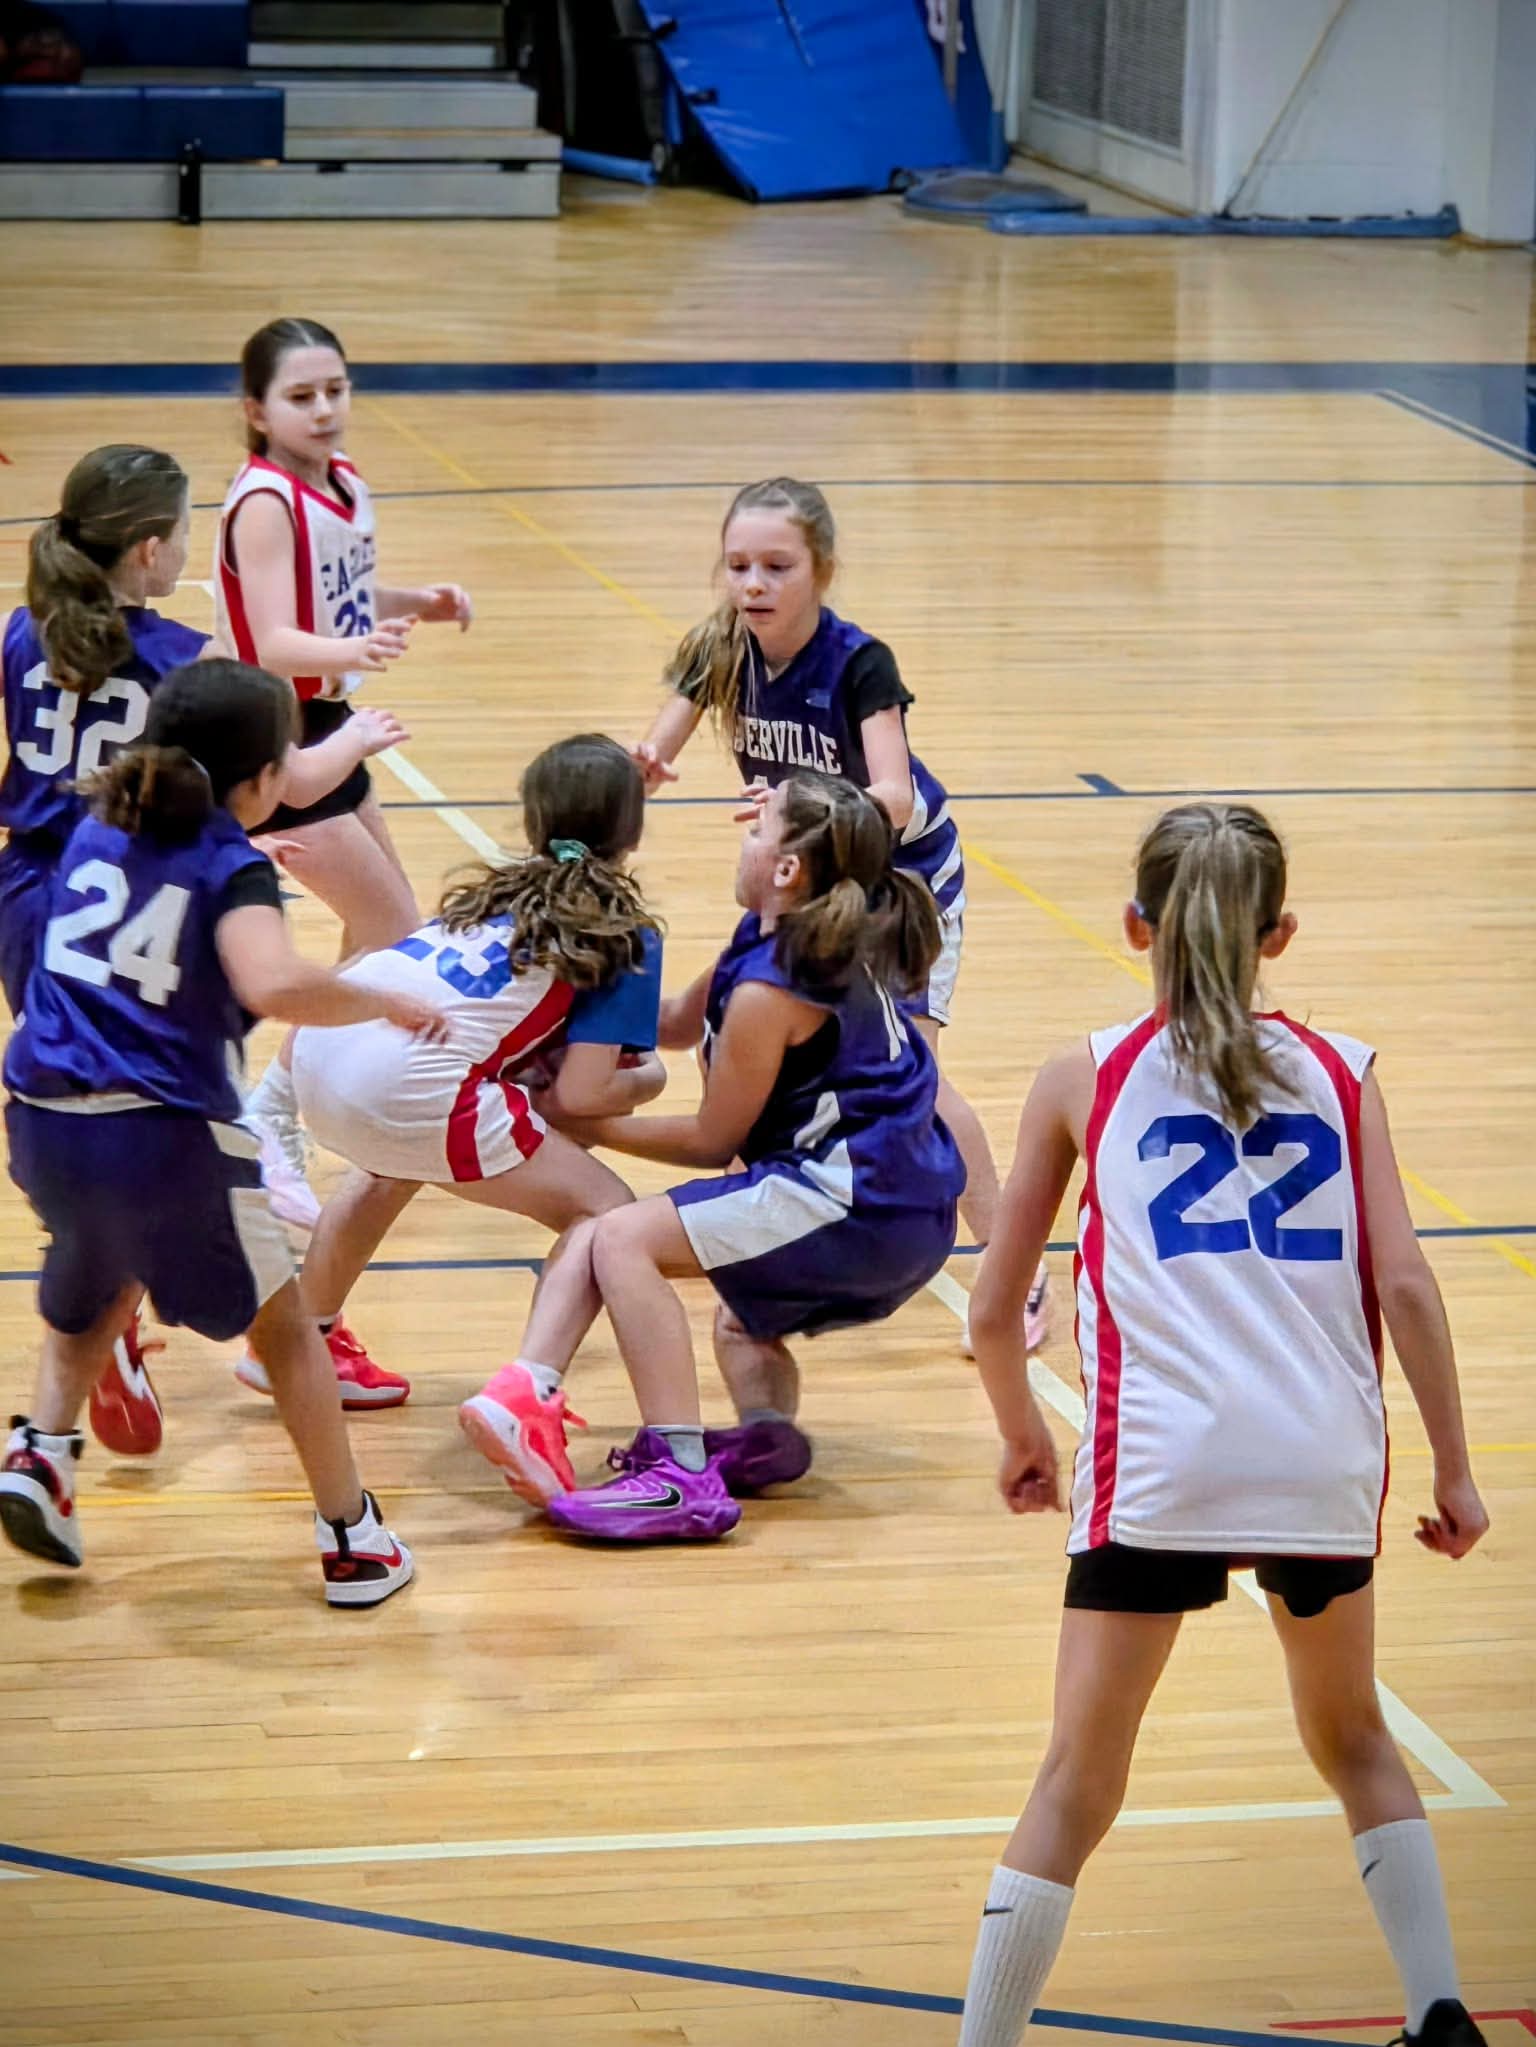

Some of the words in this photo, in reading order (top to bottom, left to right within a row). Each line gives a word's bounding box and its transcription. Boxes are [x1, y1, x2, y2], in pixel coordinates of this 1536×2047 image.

[15, 661, 151, 782] 32
[44, 858, 191, 1006] 24
[1137, 1112, 1342, 1261] 22
